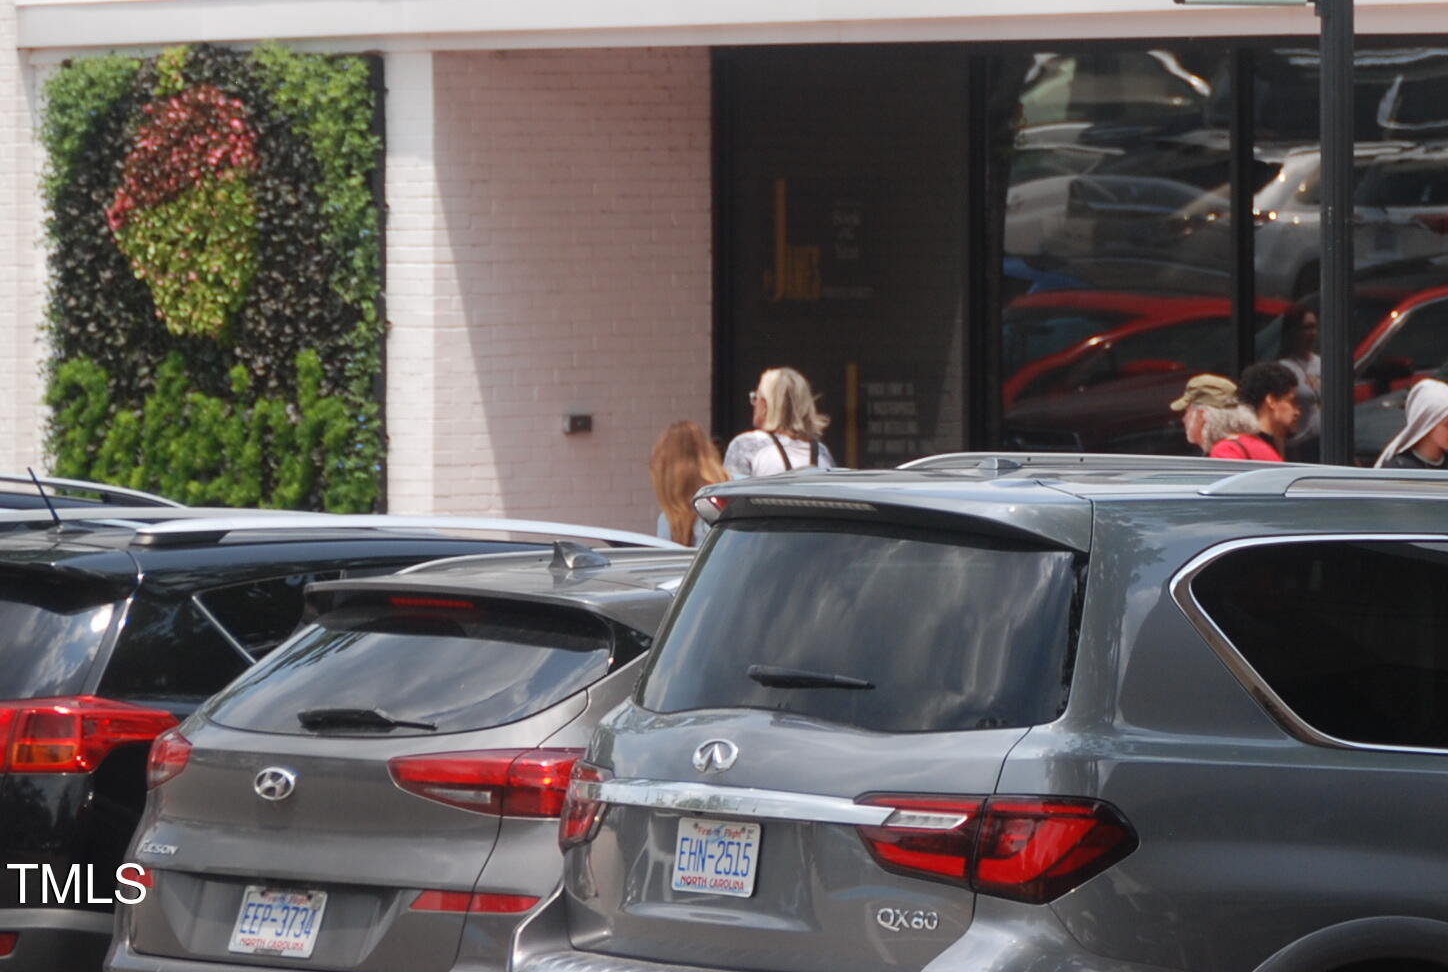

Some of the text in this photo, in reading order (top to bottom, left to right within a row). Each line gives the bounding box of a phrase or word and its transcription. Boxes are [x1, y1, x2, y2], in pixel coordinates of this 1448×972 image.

[677, 837, 753, 877] EHN-2515
[680, 876, 744, 890] NORTH CAROLINA
[240, 938, 304, 951] NORTH CAROLINA
